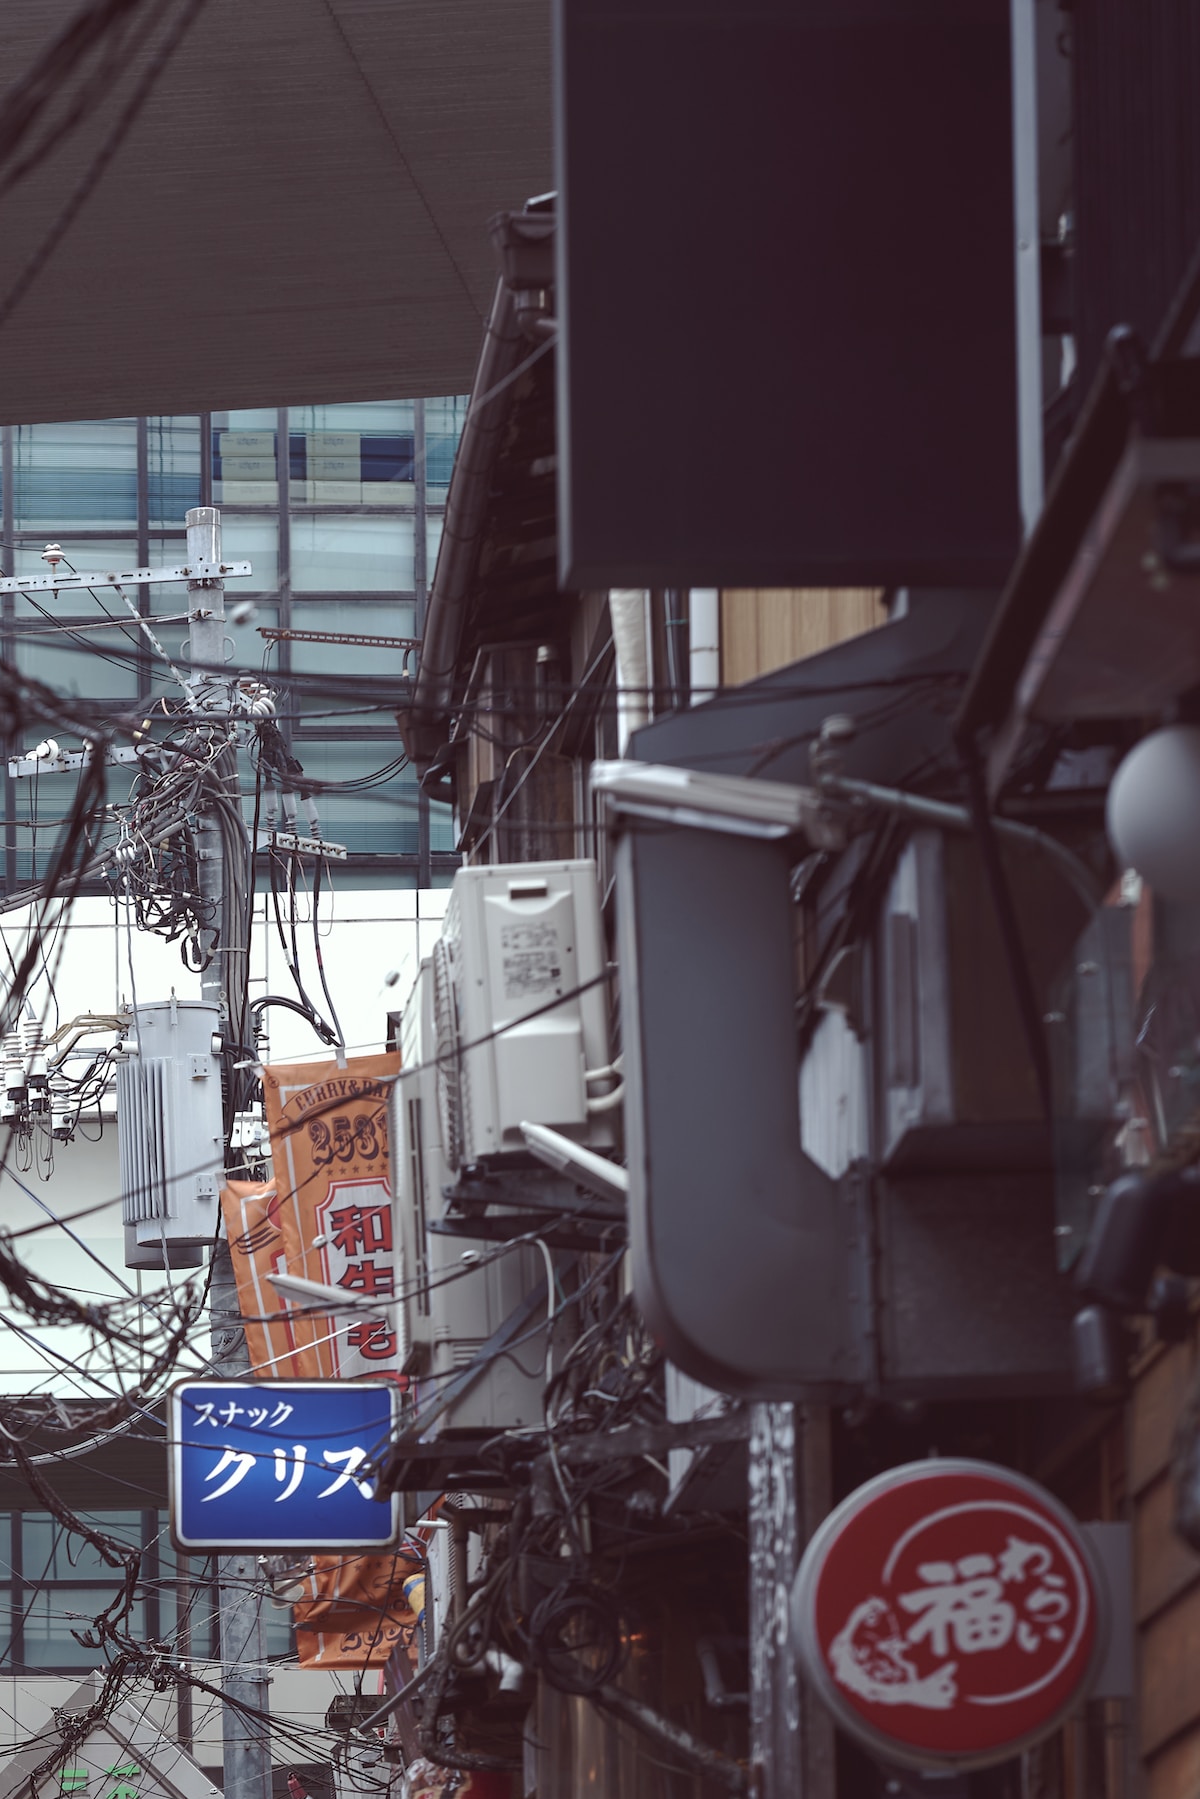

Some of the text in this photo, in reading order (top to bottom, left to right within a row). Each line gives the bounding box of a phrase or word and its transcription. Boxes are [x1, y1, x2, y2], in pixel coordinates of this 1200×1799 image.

[192, 1401, 294, 1428] スナック
[200, 1443, 375, 1503] クリス
